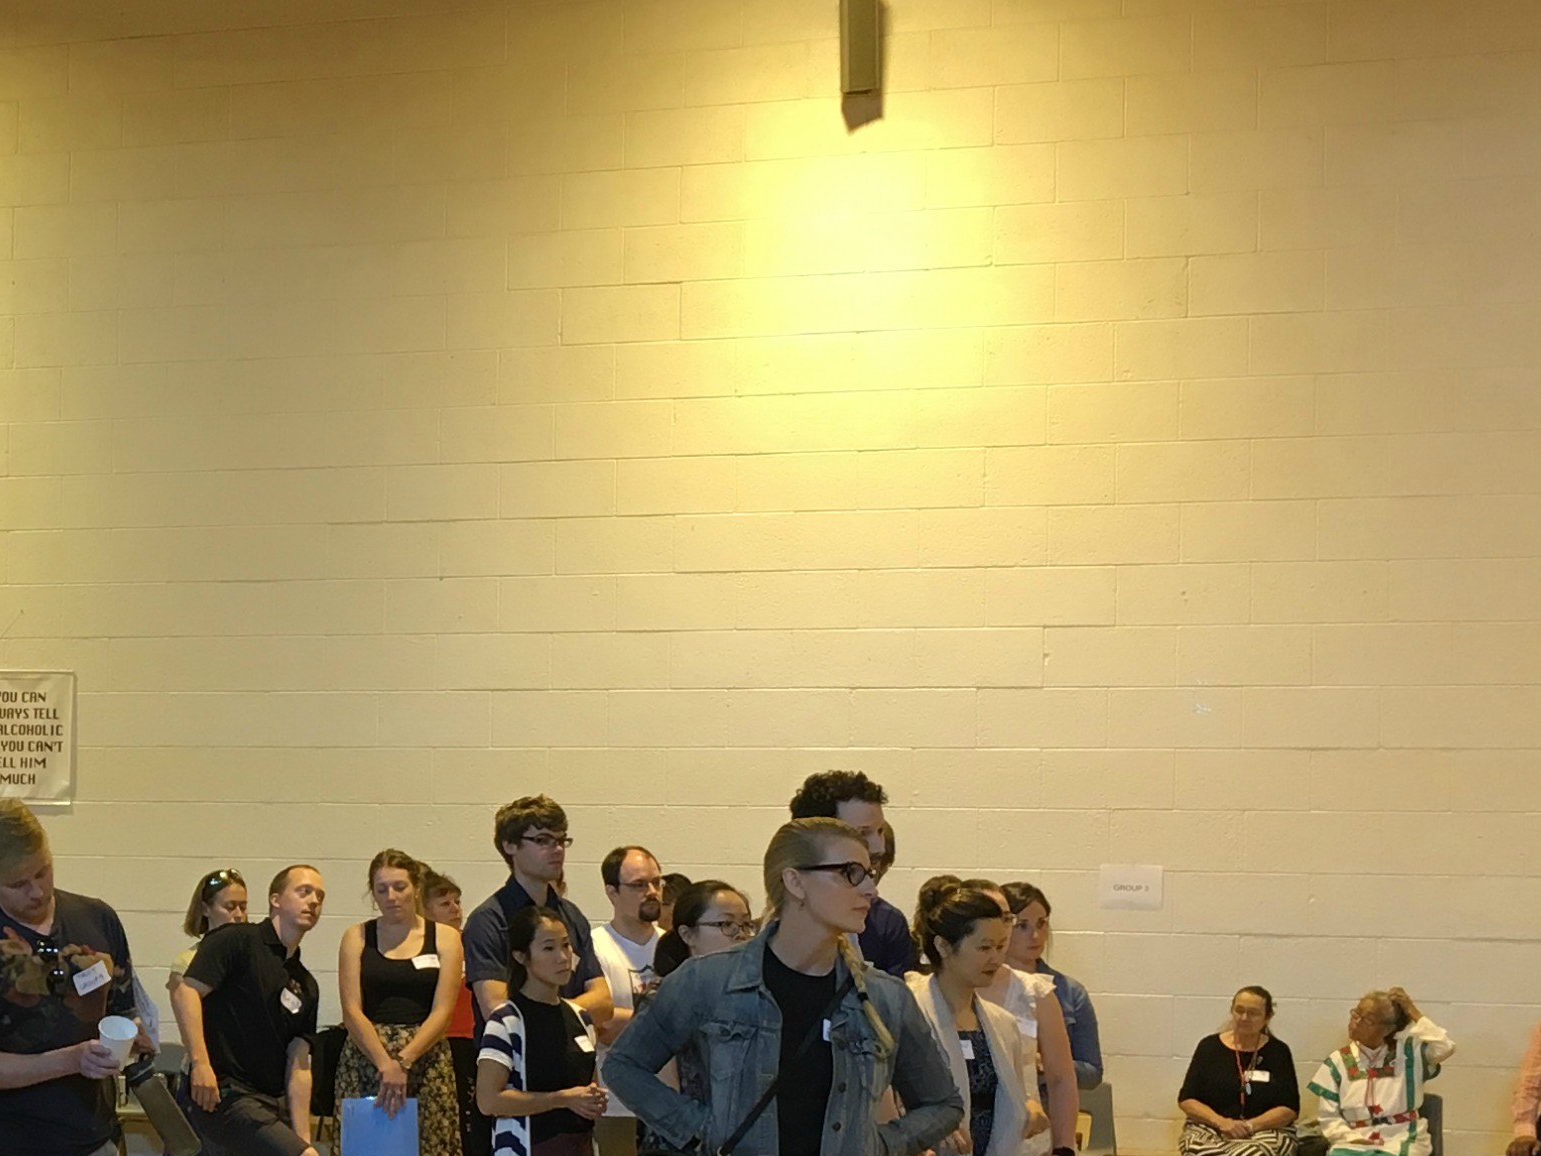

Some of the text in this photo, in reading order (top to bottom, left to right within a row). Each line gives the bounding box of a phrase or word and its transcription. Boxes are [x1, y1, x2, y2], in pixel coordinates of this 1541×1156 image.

[21, 691, 46, 703] CAN
[33, 708, 60, 720] TELL
[0, 740, 24, 752] YOU
[27, 740, 64, 753] CAN'T
[20, 757, 47, 769] HIM
[0, 773, 36, 785] MUCH
